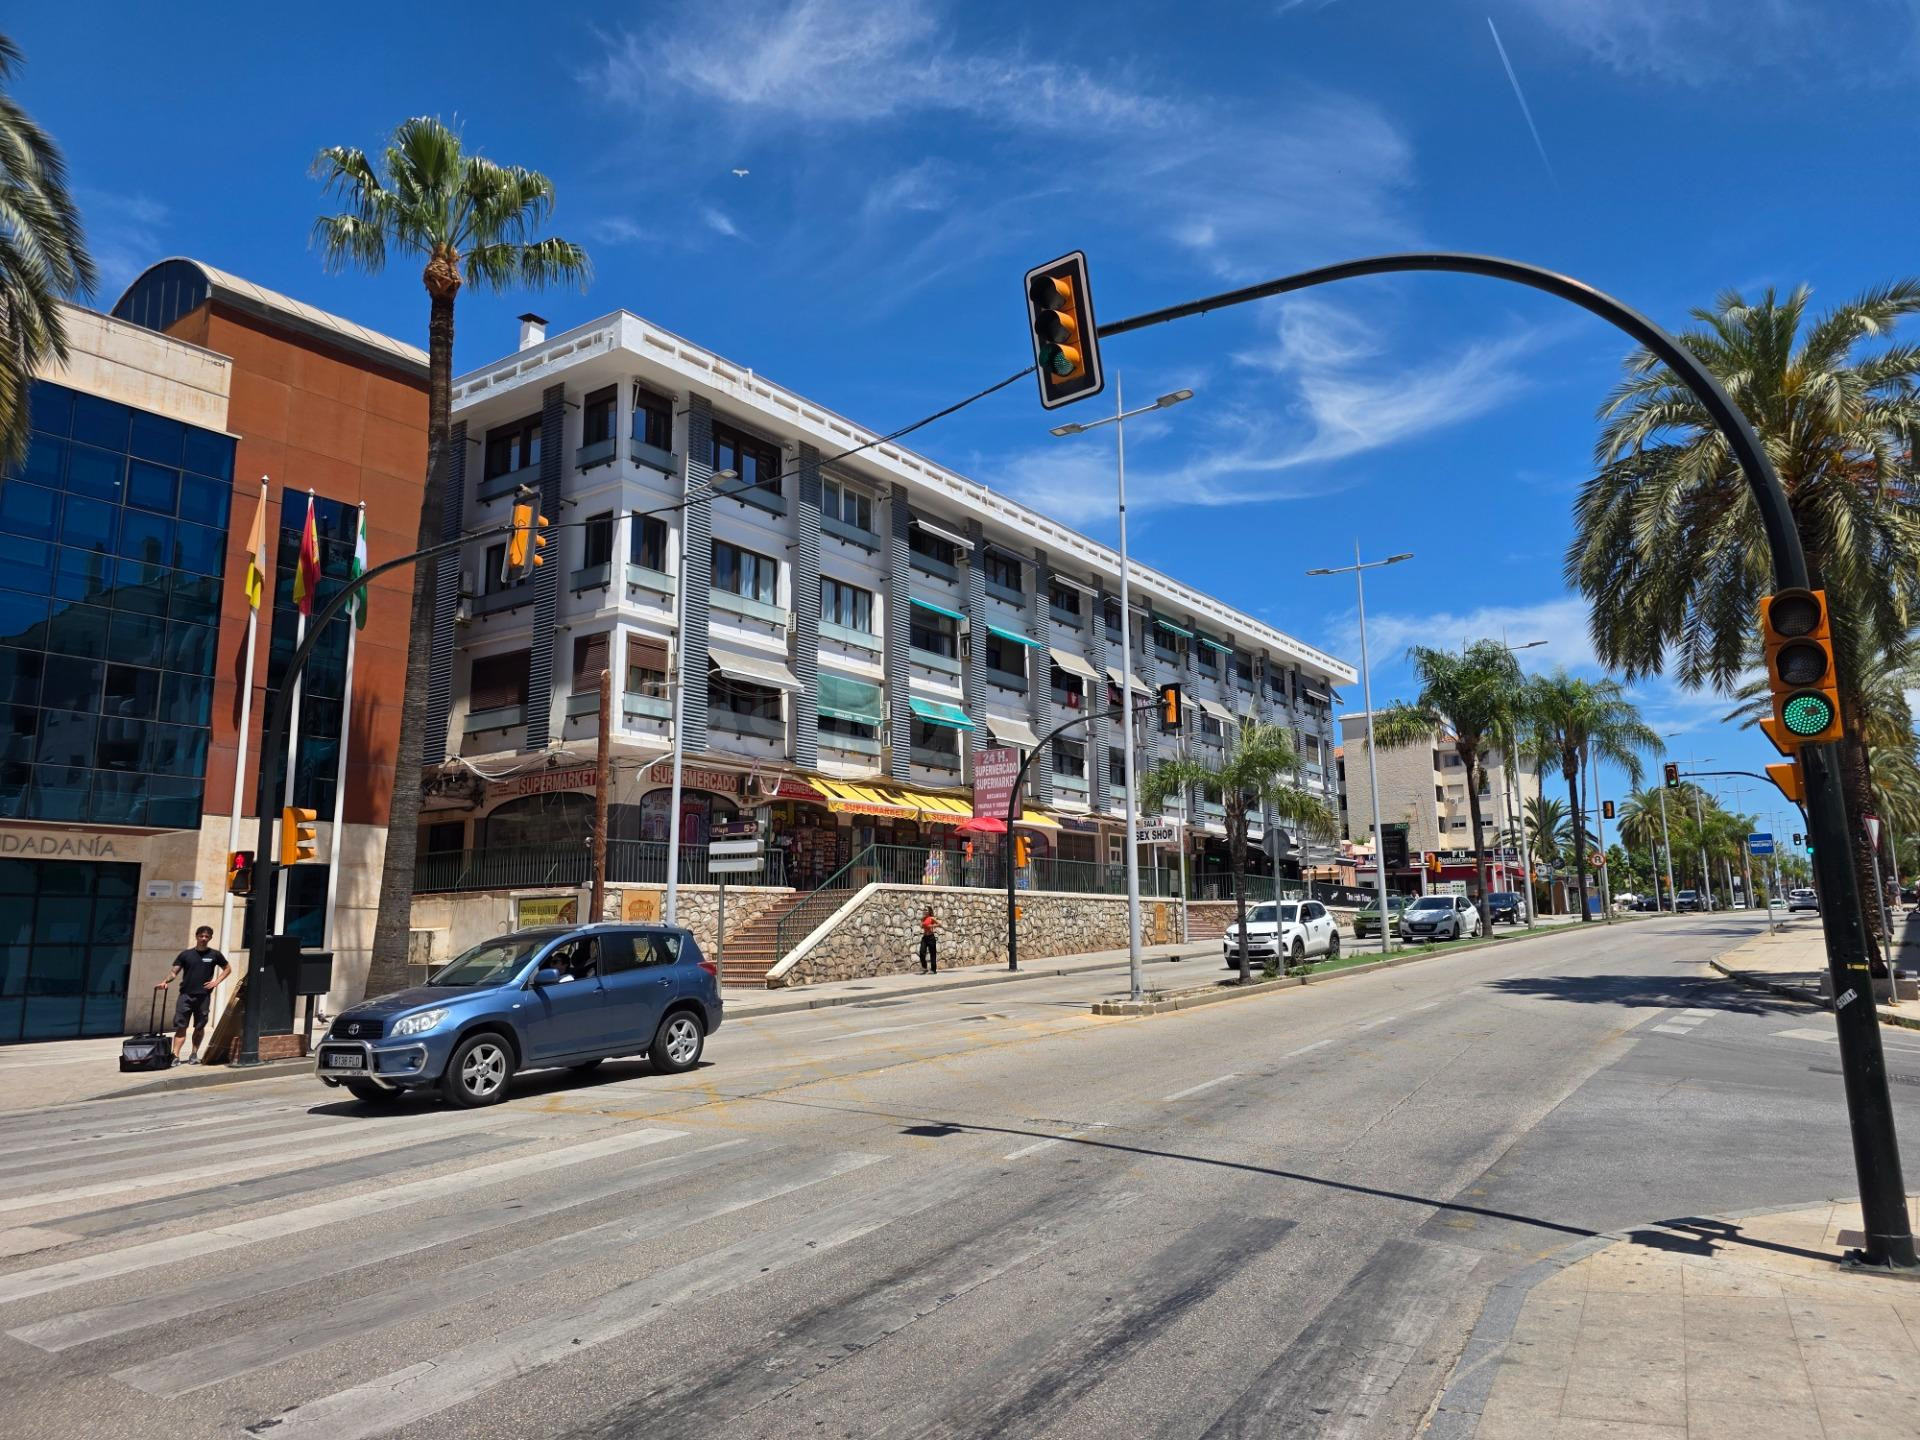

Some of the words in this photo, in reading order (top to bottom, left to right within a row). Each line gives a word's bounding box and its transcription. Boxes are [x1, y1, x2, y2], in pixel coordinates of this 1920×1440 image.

[983, 752, 995, 765] 24
[974, 763, 1017, 777] SUPERMERCADO
[519, 769, 596, 794] SUPERMARKET
[653, 766, 737, 792] SUPRMERCADO
[976, 775, 1017, 790] SUPERMARKET
[1152, 829, 1173, 840] SHOP
[0, 834, 116, 857] DADANÍA
